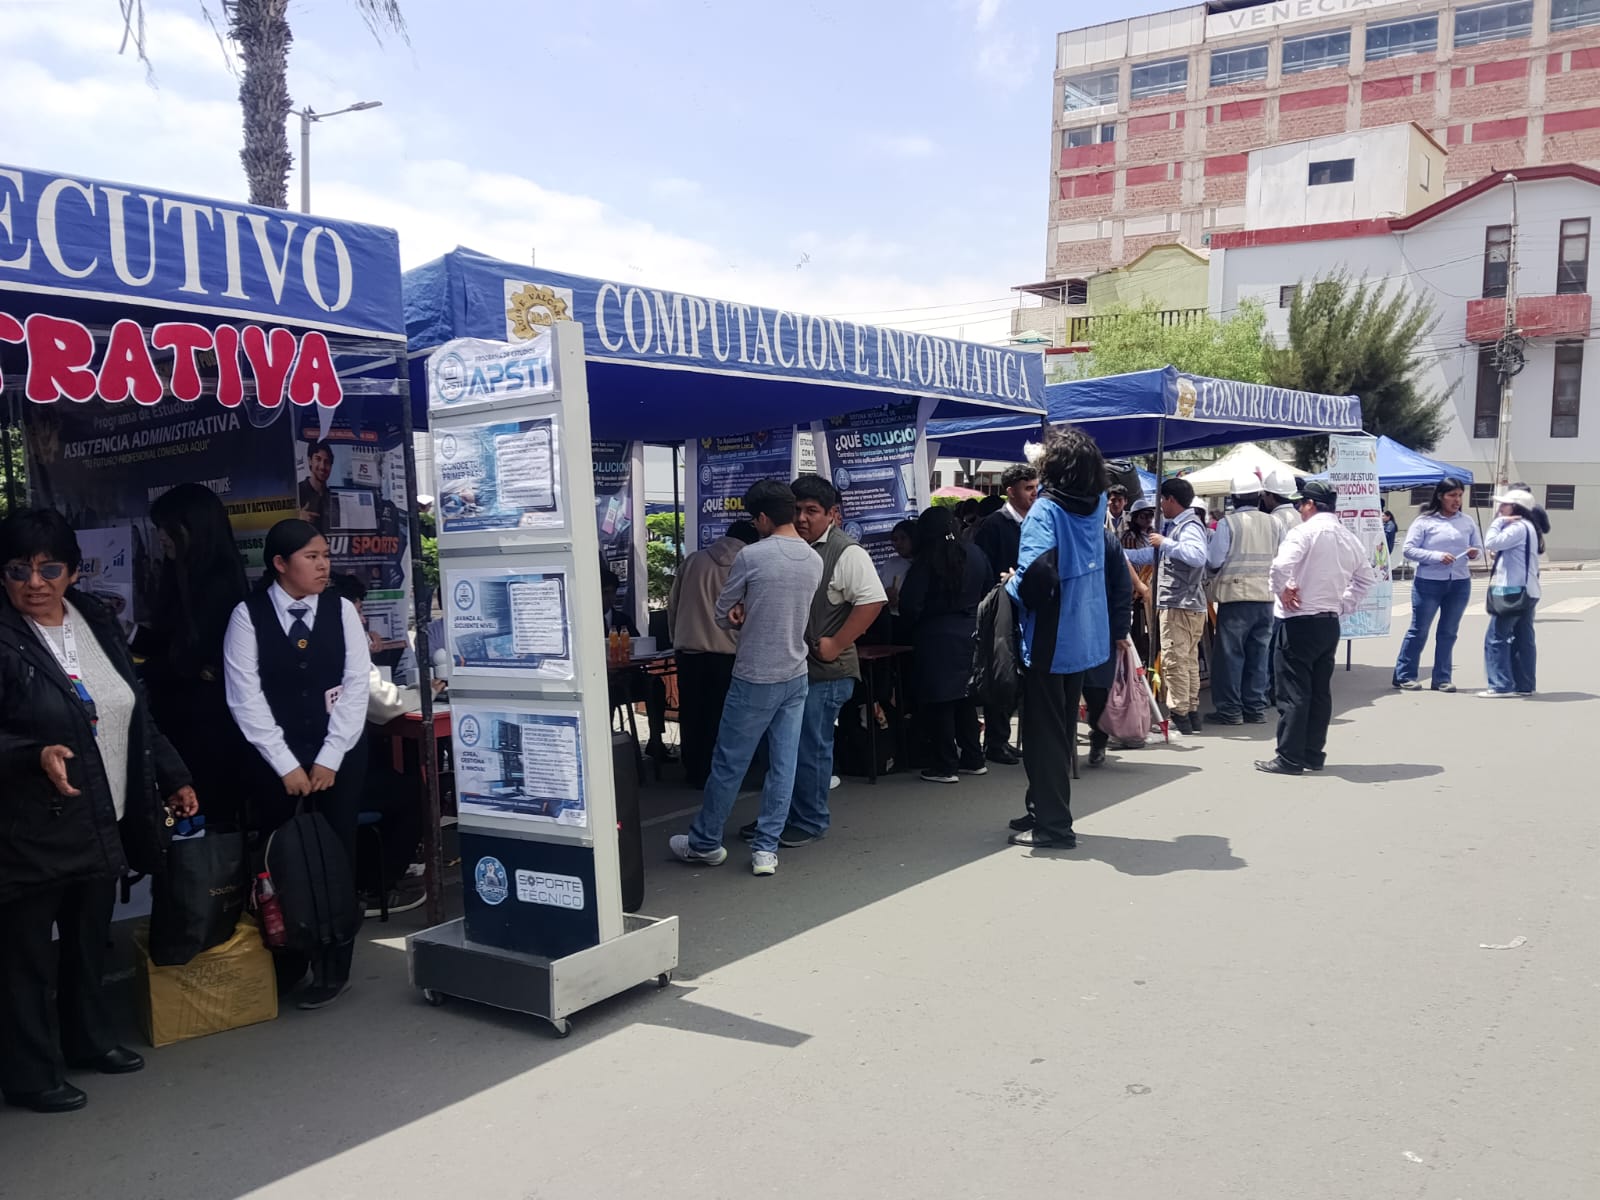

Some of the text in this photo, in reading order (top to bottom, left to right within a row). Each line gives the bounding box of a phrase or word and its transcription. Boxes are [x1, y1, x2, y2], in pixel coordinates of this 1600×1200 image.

[595, 283, 1032, 402] COMPUTACION E INFORMATICA
[468, 356, 549, 396] APSTI
[1202, 379, 1357, 427] CONSTRUCCION CIVIL
[64, 411, 241, 460] ASISTENCIA ADMINISTRATIVA
[835, 431, 863, 451] ¿QUÉ
[702, 495, 724, 513] ¿QUÉ
[351, 536, 400, 555] SPORTS
[518, 874, 582, 893] SOPORTE
